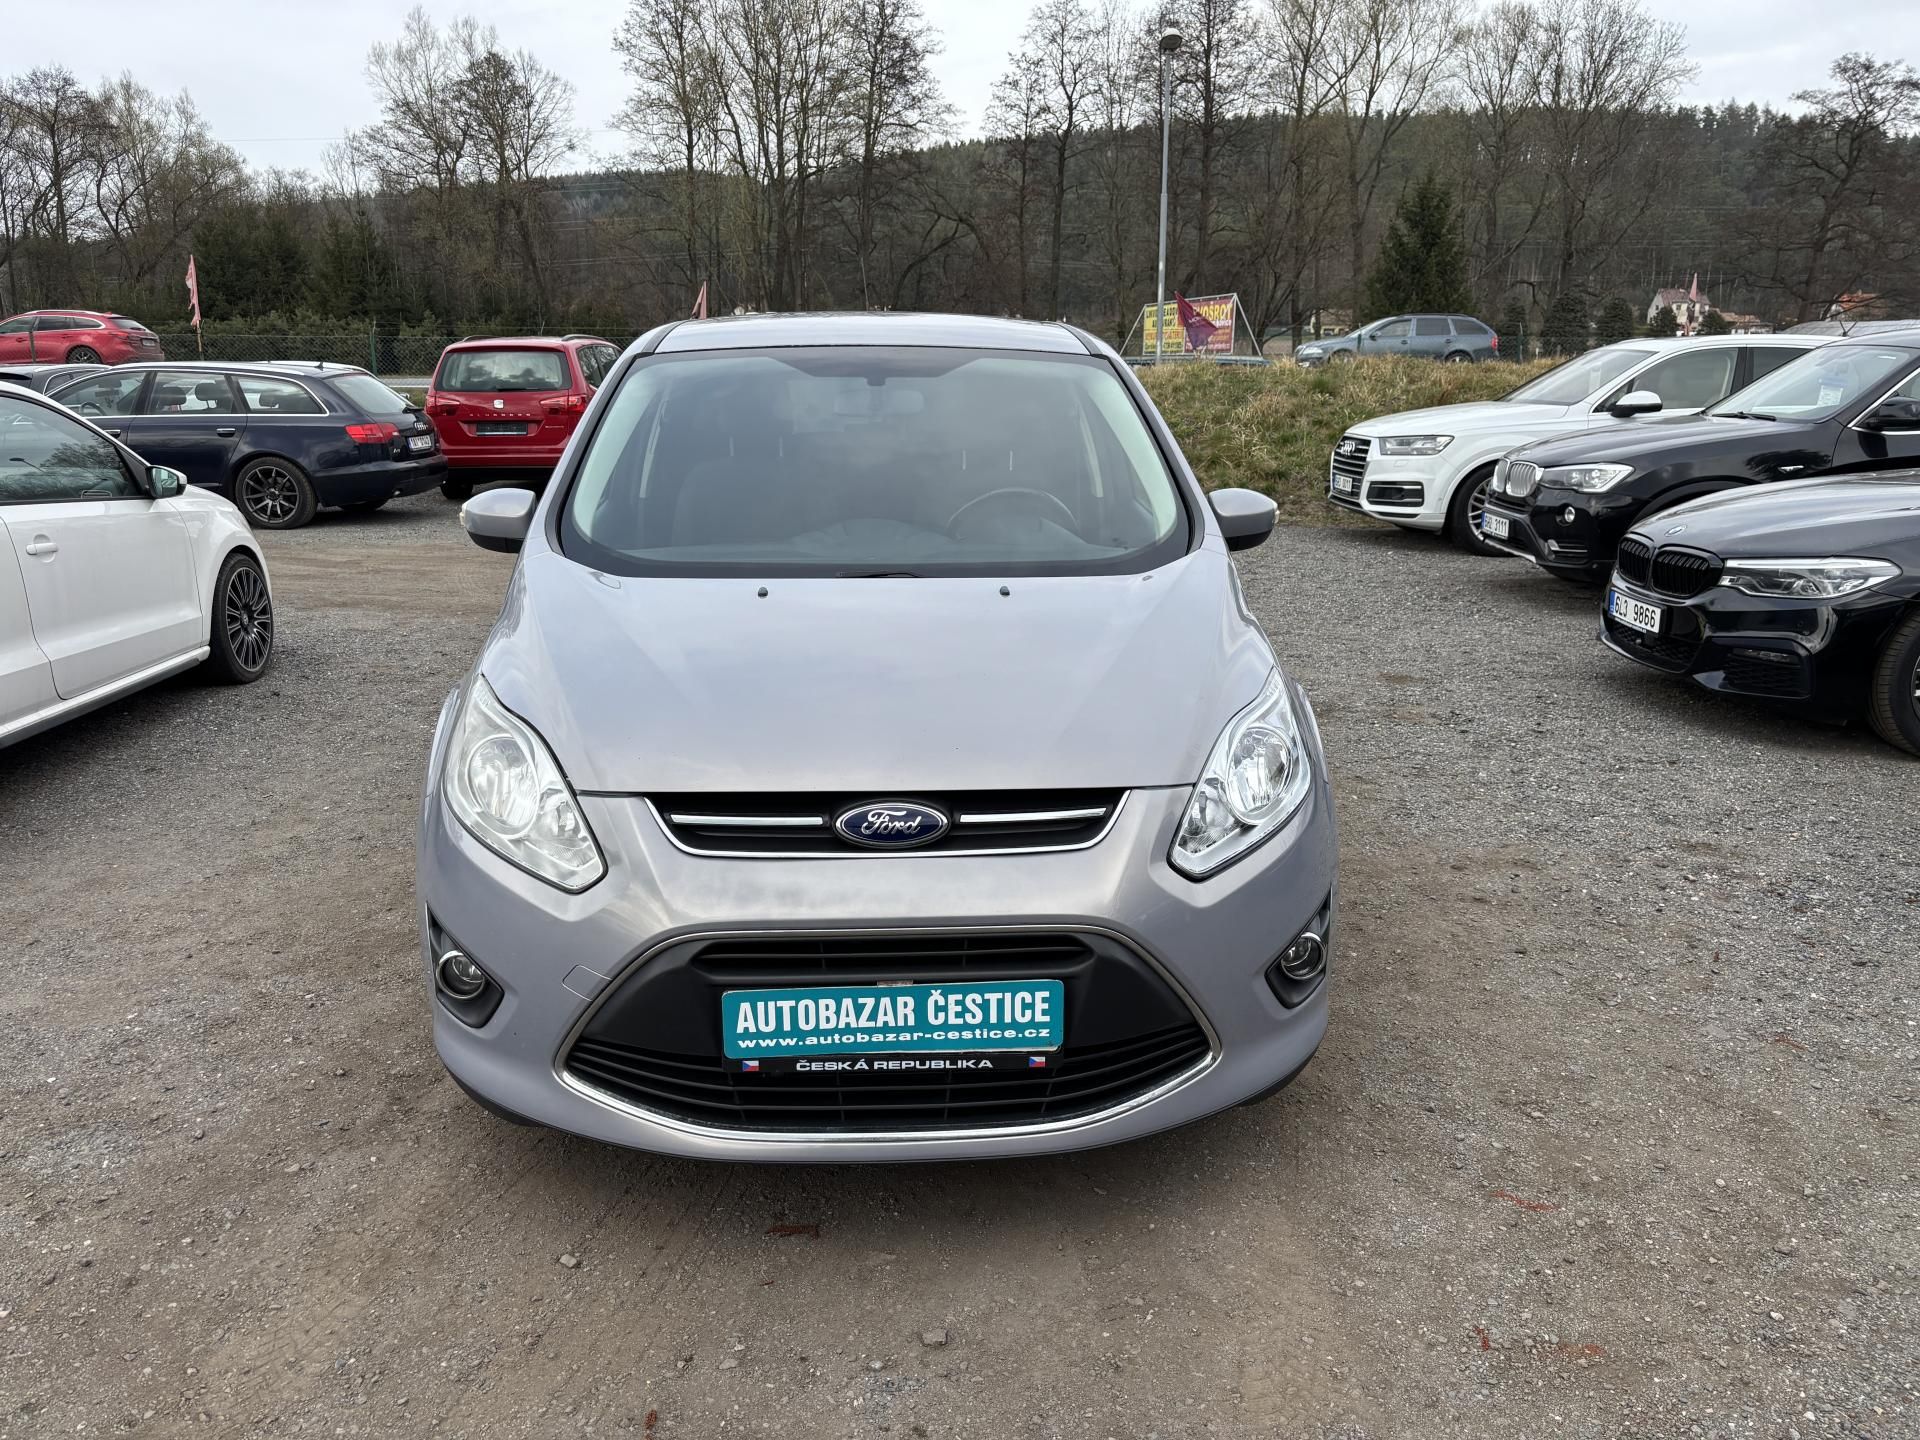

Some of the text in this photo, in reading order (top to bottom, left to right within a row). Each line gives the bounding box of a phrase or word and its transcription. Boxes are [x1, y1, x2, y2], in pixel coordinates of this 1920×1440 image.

[1615, 595, 1629, 617] 6L3
[1633, 603, 1656, 628] 9866
[861, 809, 922, 835] Ford
[736, 989, 1051, 1034] AUTOBAZAR ČESTICE
[737, 1028, 1051, 1048] www.autobazar-cestice.cz
[796, 1058, 994, 1071] ČESKÁ REPUBLIKA
